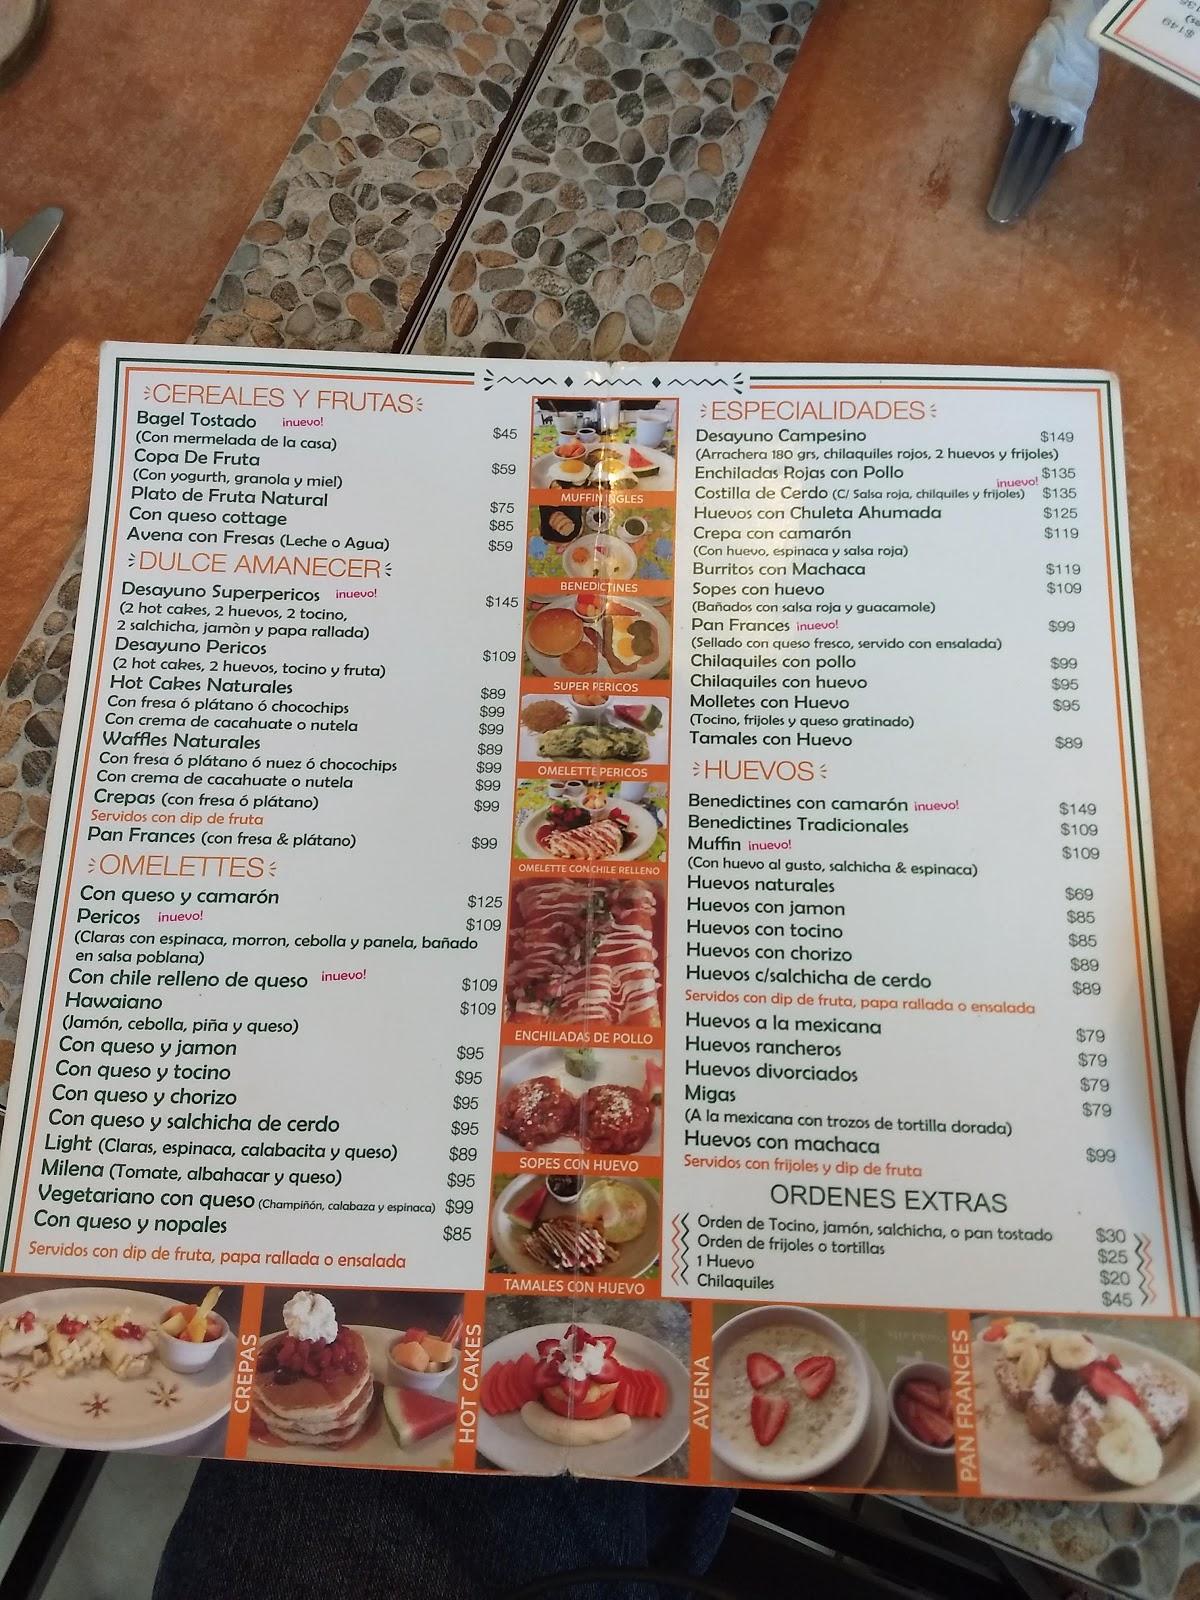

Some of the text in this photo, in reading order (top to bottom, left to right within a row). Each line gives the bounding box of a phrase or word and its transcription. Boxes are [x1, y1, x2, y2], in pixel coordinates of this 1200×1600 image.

[153, 383, 413, 413] CEREALES Y FRUTAS
[137, 410, 257, 428] Bagel Tostado
[712, 400, 925, 421] ESPECIALIDADES
[136, 430, 337, 452] (Con mermelada de la casa)
[493, 426, 517, 440] $45
[696, 428, 867, 445] Desayuno Campesino
[1040, 430, 1074, 443] $149
[695, 447, 1059, 462] (Arrachera 180 grs, chilaquiles rojos, 2 huevos y frijoles)
[491, 462, 516, 475] $59
[1042, 467, 1076, 479] $135
[131, 486, 328, 507] Plato de Fruta Natural
[561, 493, 644, 505] MUFFIN INGLES
[694, 485, 1025, 501] Costilla de Cerdo (C/ Salsa roja, chilquiles y frijoles)
[1043, 487, 1077, 499] $135
[490, 501, 515, 514] $75
[126, 526, 390, 552] Avena con Fresas (Leche o Agua)
[1044, 526, 1079, 539] $119
[488, 539, 513, 552] $59
[139, 551, 381, 578] DULCE AMANECER
[693, 562, 866, 576] Burritos con Machaca
[1046, 563, 1081, 576] $119
[121, 581, 320, 603] Desayuno Superpericos
[560, 581, 638, 593] BENEDICTINES
[485, 595, 519, 608] $145
[691, 617, 790, 632] Pan Frances
[1048, 620, 1075, 633] $99
[1050, 656, 1078, 670] $99
[110, 674, 293, 694] Hot Cakes Naturales
[553, 681, 639, 693] SUPER PERICOS
[480, 686, 506, 700] $89
[537, 765, 648, 778] OMELETTE PERICOS
[705, 760, 814, 781] HUEVOS
[91, 809, 264, 826] Servidos con dip de fruta
[688, 814, 909, 834] Benedictines Tradicionales
[1060, 822, 1098, 836] $109
[688, 835, 741, 851] Muffin
[1062, 846, 1100, 860] $109
[100, 854, 264, 878] OMELETTES
[518, 864, 660, 875] OMELETTE CON CHILE RELLENO
[1065, 887, 1094, 901] $69
[77, 907, 140, 925] Pericos
[466, 917, 502, 932] $109
[68, 967, 308, 991] Con chile relleno de queso
[461, 977, 498, 992] $109
[686, 964, 932, 989] Huevos c/salchicha de cerdo
[65, 991, 163, 1010] Hawaiano
[460, 1000, 496, 1016] $109
[515, 1030, 653, 1045] ENCHILADAS DE POLLO
[685, 1059, 858, 1082] Huevos divorciados
[685, 1084, 736, 1104] Migas
[41, 1158, 342, 1187] Milena (Tomate, albahacar y queso)
[519, 1157, 639, 1172] SOPES CON HUEVO
[447, 1171, 475, 1189] $95
[38, 1183, 436, 1215] Vegetariano con queso (Champiñón, calabaza y espinaca)
[445, 1198, 474, 1216] $99
[770, 1184, 1008, 1213] ORDENES EXTRAS
[697, 1214, 1053, 1242] Orden de Tocino, jamón, salchicha, o pan tostado
[1096, 1227, 1126, 1243] $30
[697, 1253, 755, 1269] 1 Huevo
[697, 1273, 775, 1291] Chilaquiles
[1100, 1269, 1131, 1286] $20
[503, 1278, 645, 1295] TAMALES CON HUEVO
[1102, 1290, 1133, 1308] $45
[234, 1334, 258, 1414] CREPAS
[459, 1324, 482, 1443] HOT CAKES
[692, 1355, 711, 1430] AVENA
[951, 1329, 978, 1483] PAN FRANCES
